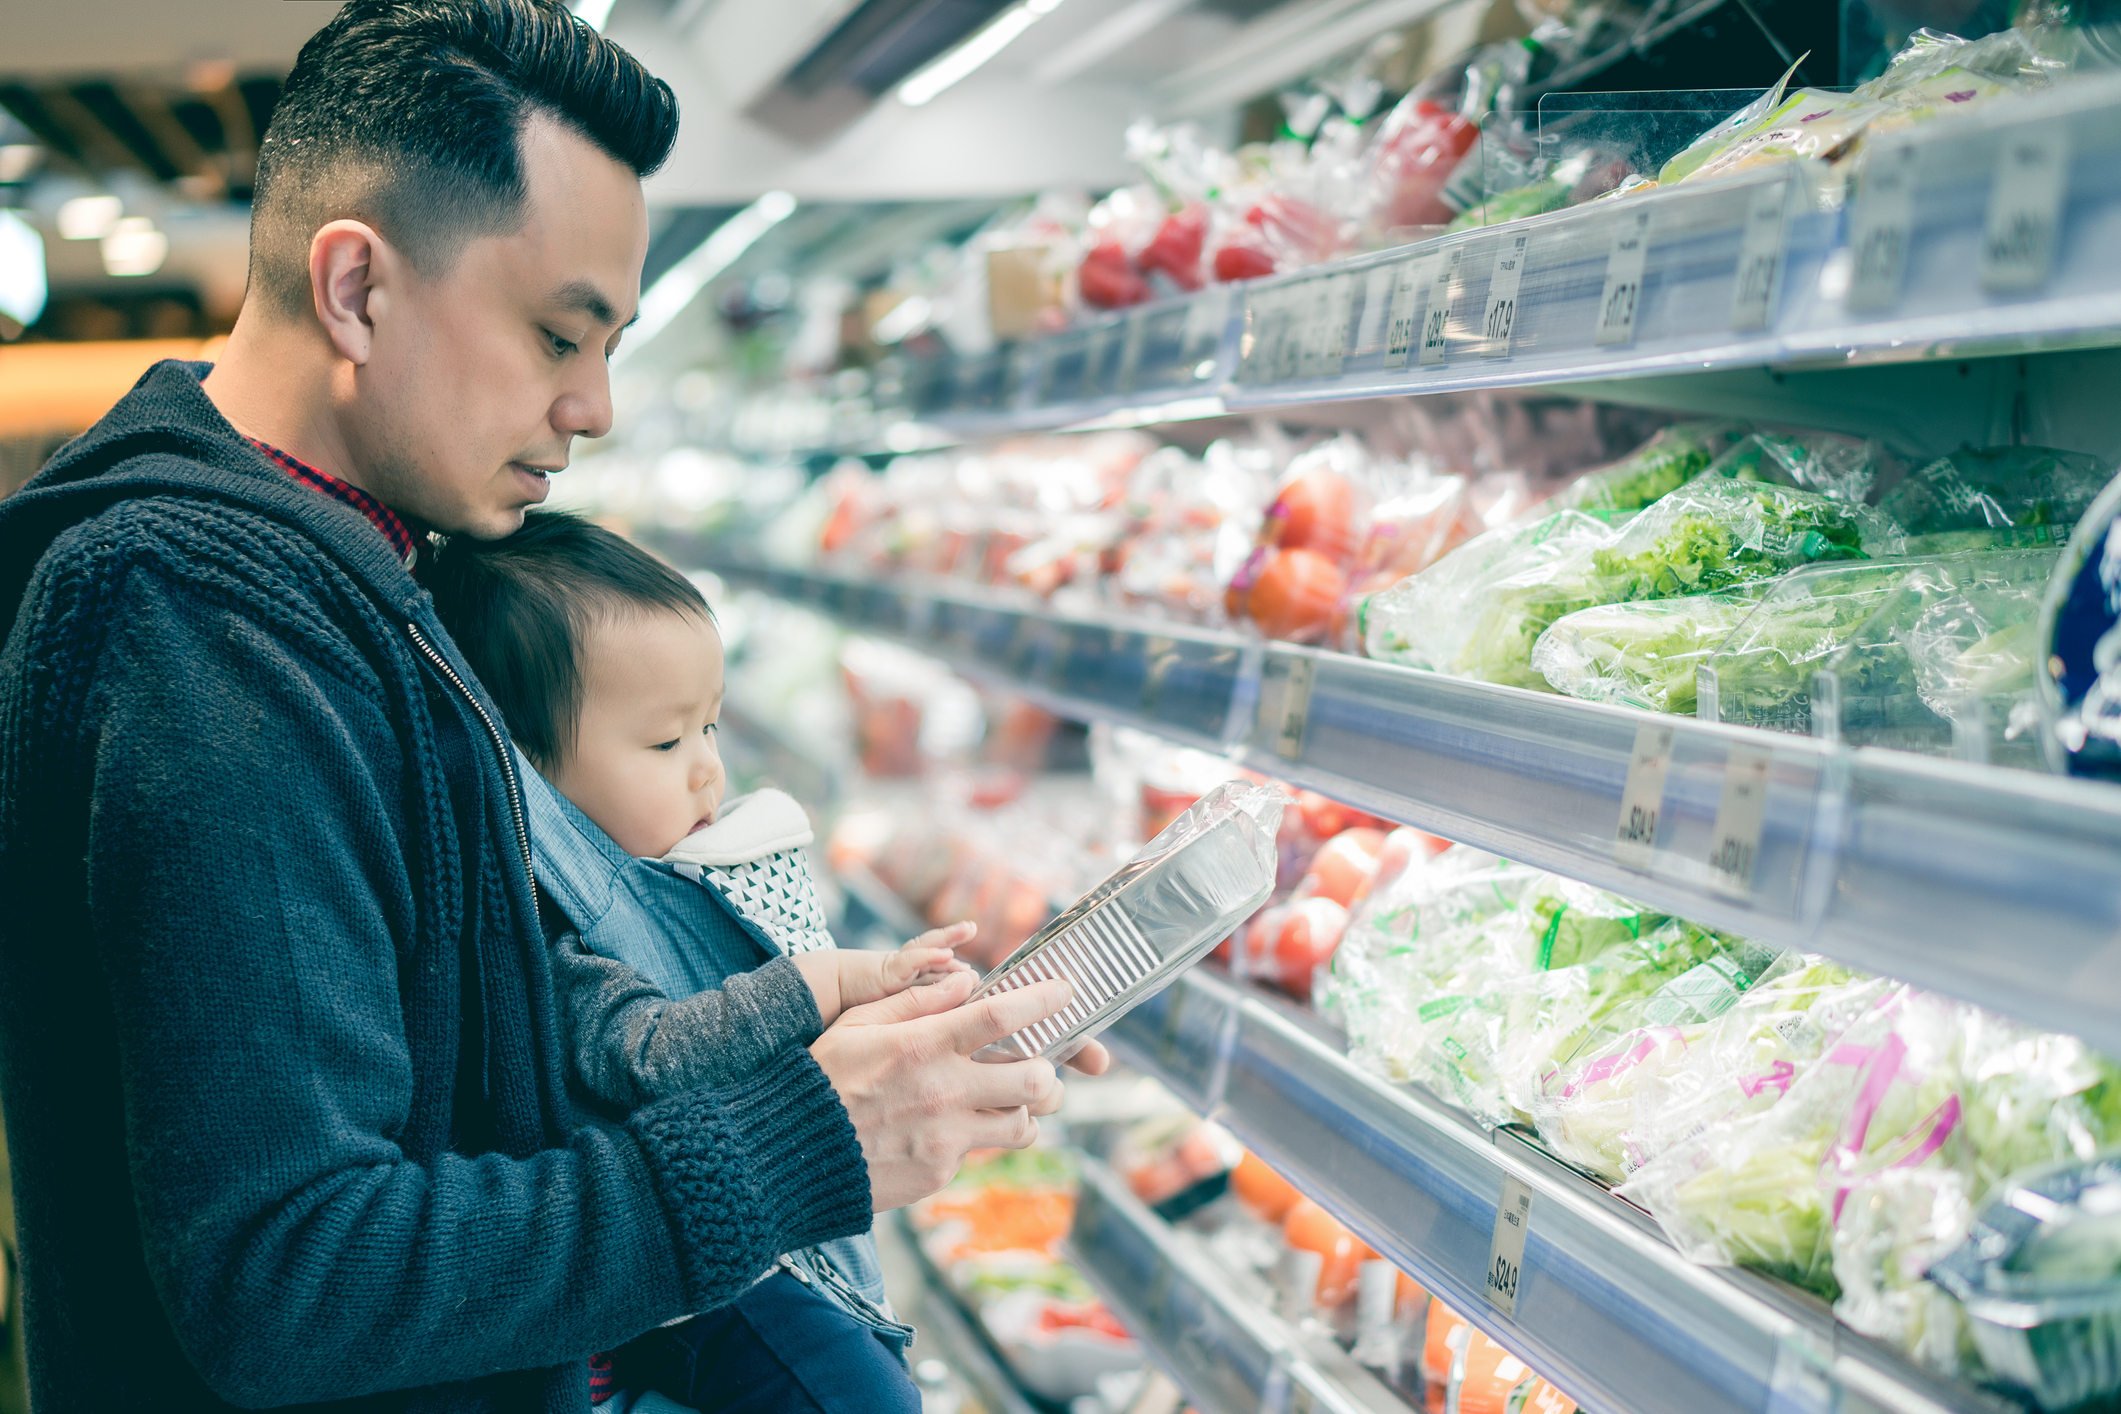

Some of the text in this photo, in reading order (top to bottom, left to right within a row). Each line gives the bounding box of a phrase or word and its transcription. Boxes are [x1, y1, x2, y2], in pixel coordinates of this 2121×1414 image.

[1425, 309, 1450, 351] $29.5
[1487, 299, 1513, 342] $17.9
[1494, 1254, 1518, 1299] $24.9
